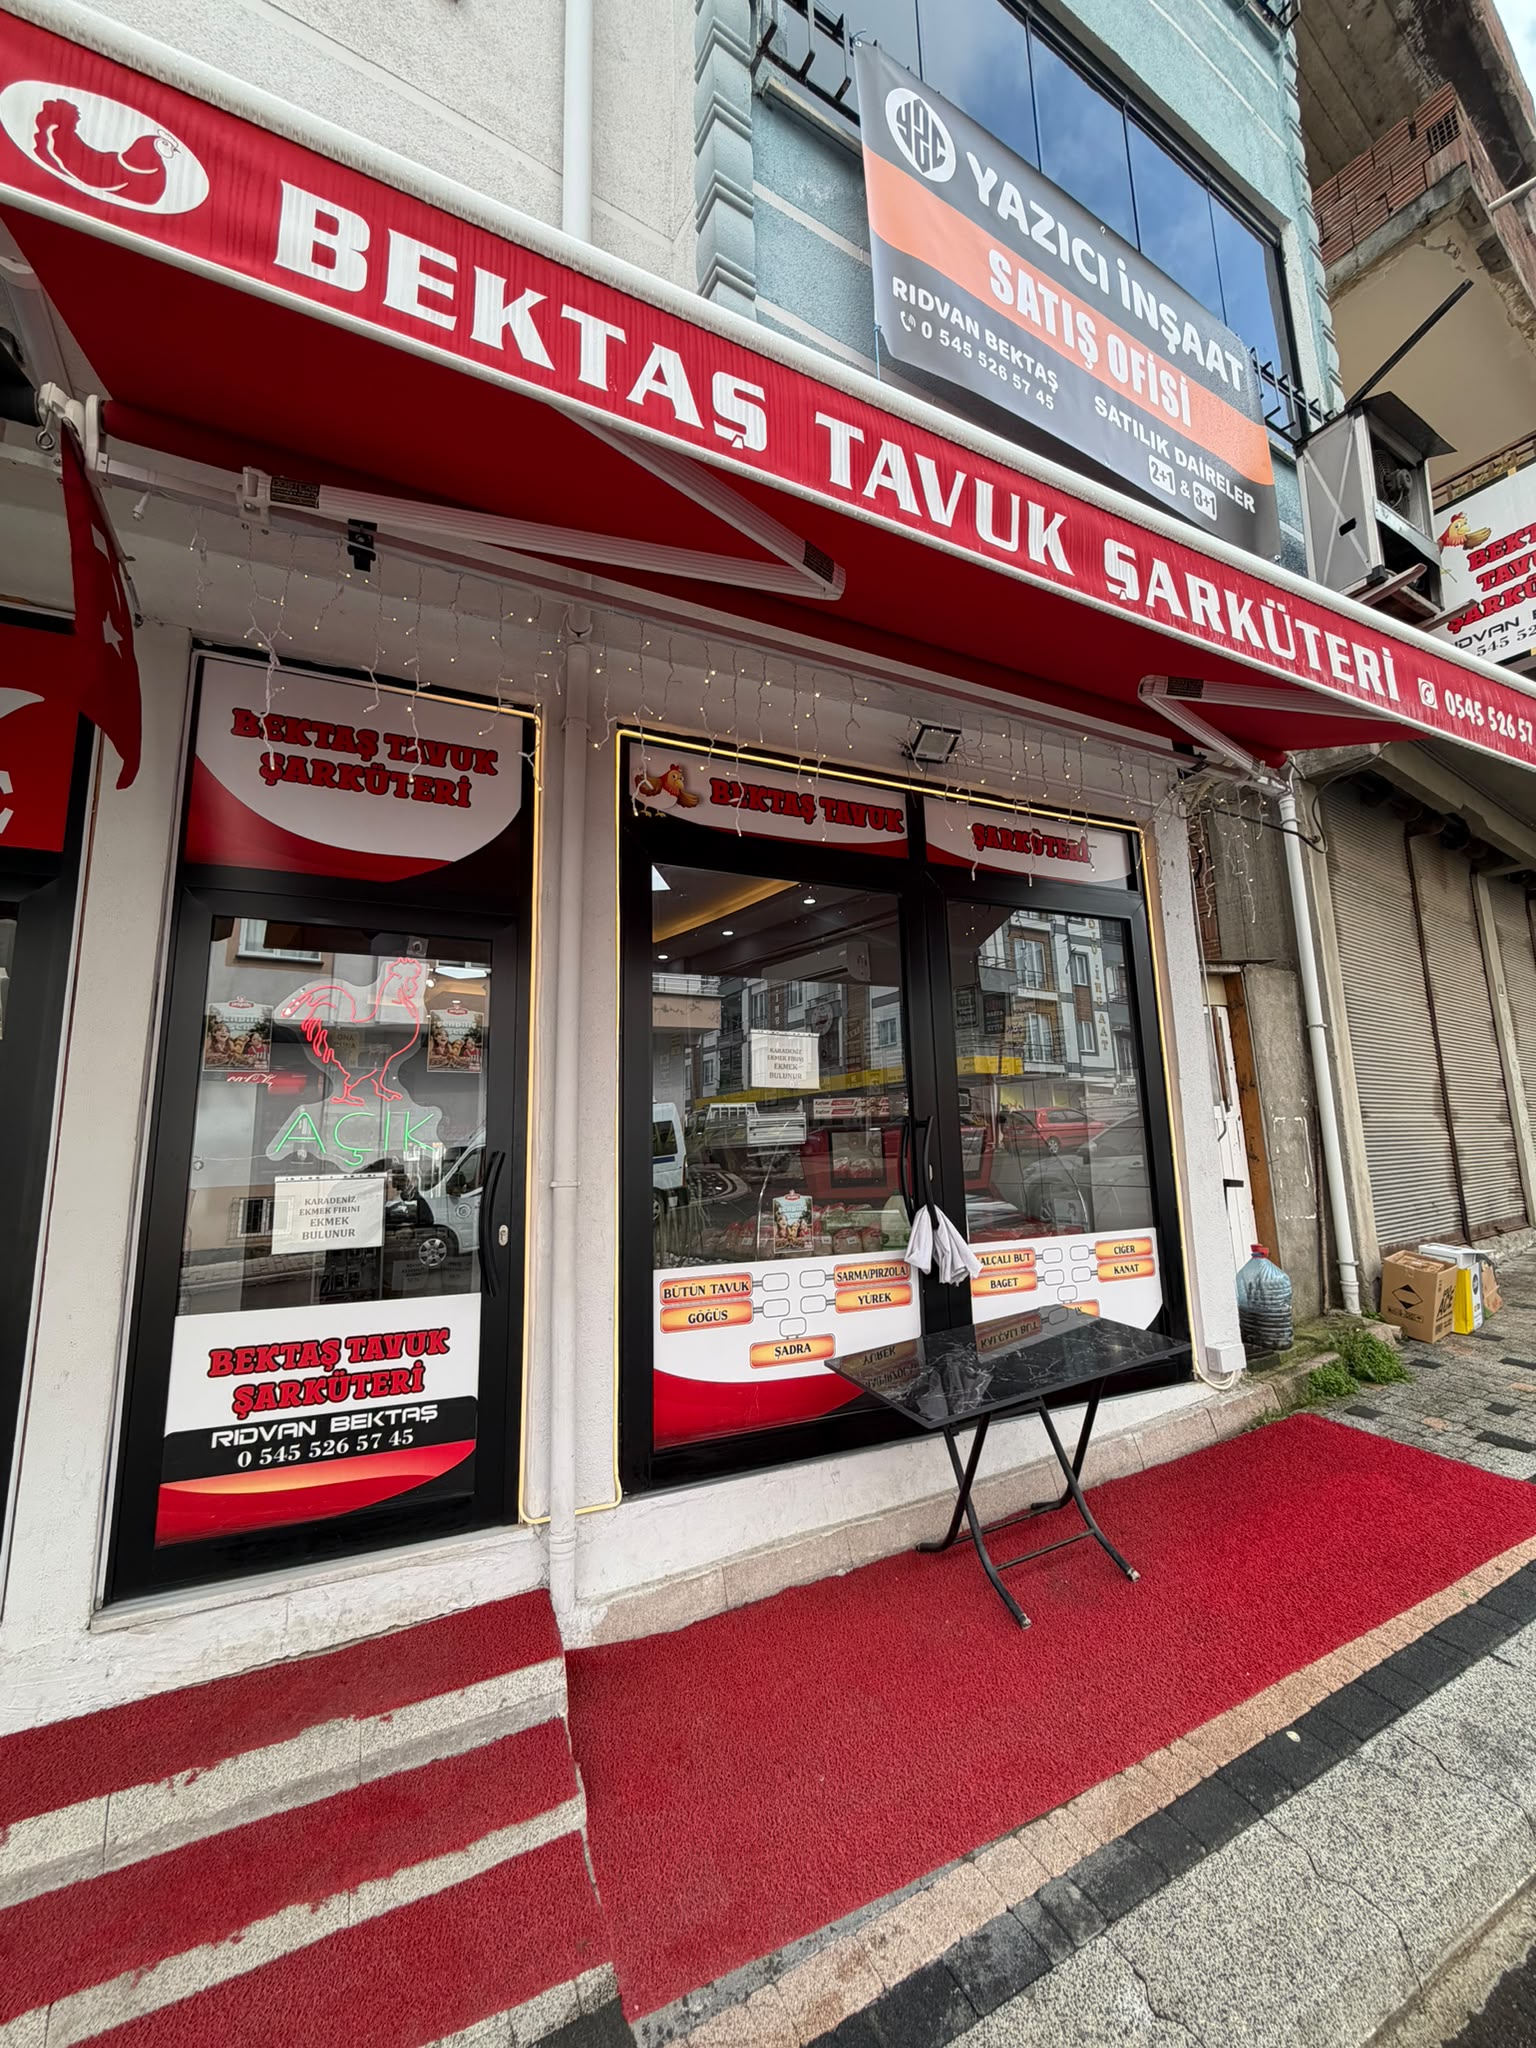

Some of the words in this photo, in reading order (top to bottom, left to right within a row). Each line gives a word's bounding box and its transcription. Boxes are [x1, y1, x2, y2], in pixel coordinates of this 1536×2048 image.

[966, 152, 1109, 295] YAZICI
[1117, 258, 1243, 391] İNŞAAT
[893, 276, 980, 340] RIDVAN
[985, 328, 1059, 394] BEKTAŞ
[988, 249, 1098, 370] SATIŞ
[1107, 333, 1192, 427] OFİSİ
[921, 321, 933, 339] 0
[939, 329, 972, 358] 545
[978, 351, 1008, 381] 526
[1013, 375, 1031, 395] 57
[1036, 391, 1055, 410] 45
[273, 180, 768, 452] BEKTAŞ
[815, 411, 1076, 577] TAVUK
[1103, 537, 1401, 702] ŞARKÜTERİ
[1444, 689, 1485, 726] 0545
[1488, 706, 1516, 740] 526
[1518, 717, 1533, 745] 57
[1094, 395, 1170, 459] SATILIK
[1174, 446, 1256, 513] DAİRELER
[1150, 460, 1175, 494] 2+1
[1180, 480, 1190, 498] &
[1193, 482, 1216, 519] 3+1
[231, 707, 379, 761] BEKTAŞ
[384, 733, 499, 776] TAVUK
[259, 752, 472, 808] ŞARKÜTERİ
[709, 777, 816, 824] BEKTAŞ
[819, 795, 905, 833] TAVUK
[971, 822, 1091, 864] ŞARKÜTERİ
[274, 1111, 442, 1166] AÇIK
[299, 1206, 331, 1216] EKMEK
[333, 1205, 360, 1214] FIRINI
[304, 1194, 357, 1206] KARADENİZ
[310, 1216, 350, 1227] EKMEK
[302, 1228, 356, 1240] BULUNUR
[977, 1254, 1011, 1267] ALÇALI
[1014, 1253, 1031, 1263] BUT
[1113, 1263, 1140, 1275] KANAT
[663, 1284, 706, 1299] BÜTÜN
[710, 1281, 749, 1295] TAVUK
[857, 1291, 892, 1305] YÜREK
[990, 1277, 1018, 1289] BAGET
[688, 1308, 728, 1324] GÖĞÜS
[207, 1337, 341, 1379] BEKTAŞ
[345, 1327, 451, 1364] TAVUK
[774, 1343, 812, 1360] ŞADRA
[232, 1360, 425, 1420] ŞARKÜTERİ
[211, 1420, 317, 1449] RIDVAN
[330, 1404, 439, 1433] BEKTAŞ
[236, 1451, 252, 1468] 0
[259, 1442, 301, 1466] 545
[308, 1437, 350, 1460] 526
[356, 1434, 381, 1453] 57
[388, 1428, 414, 1447] 45
